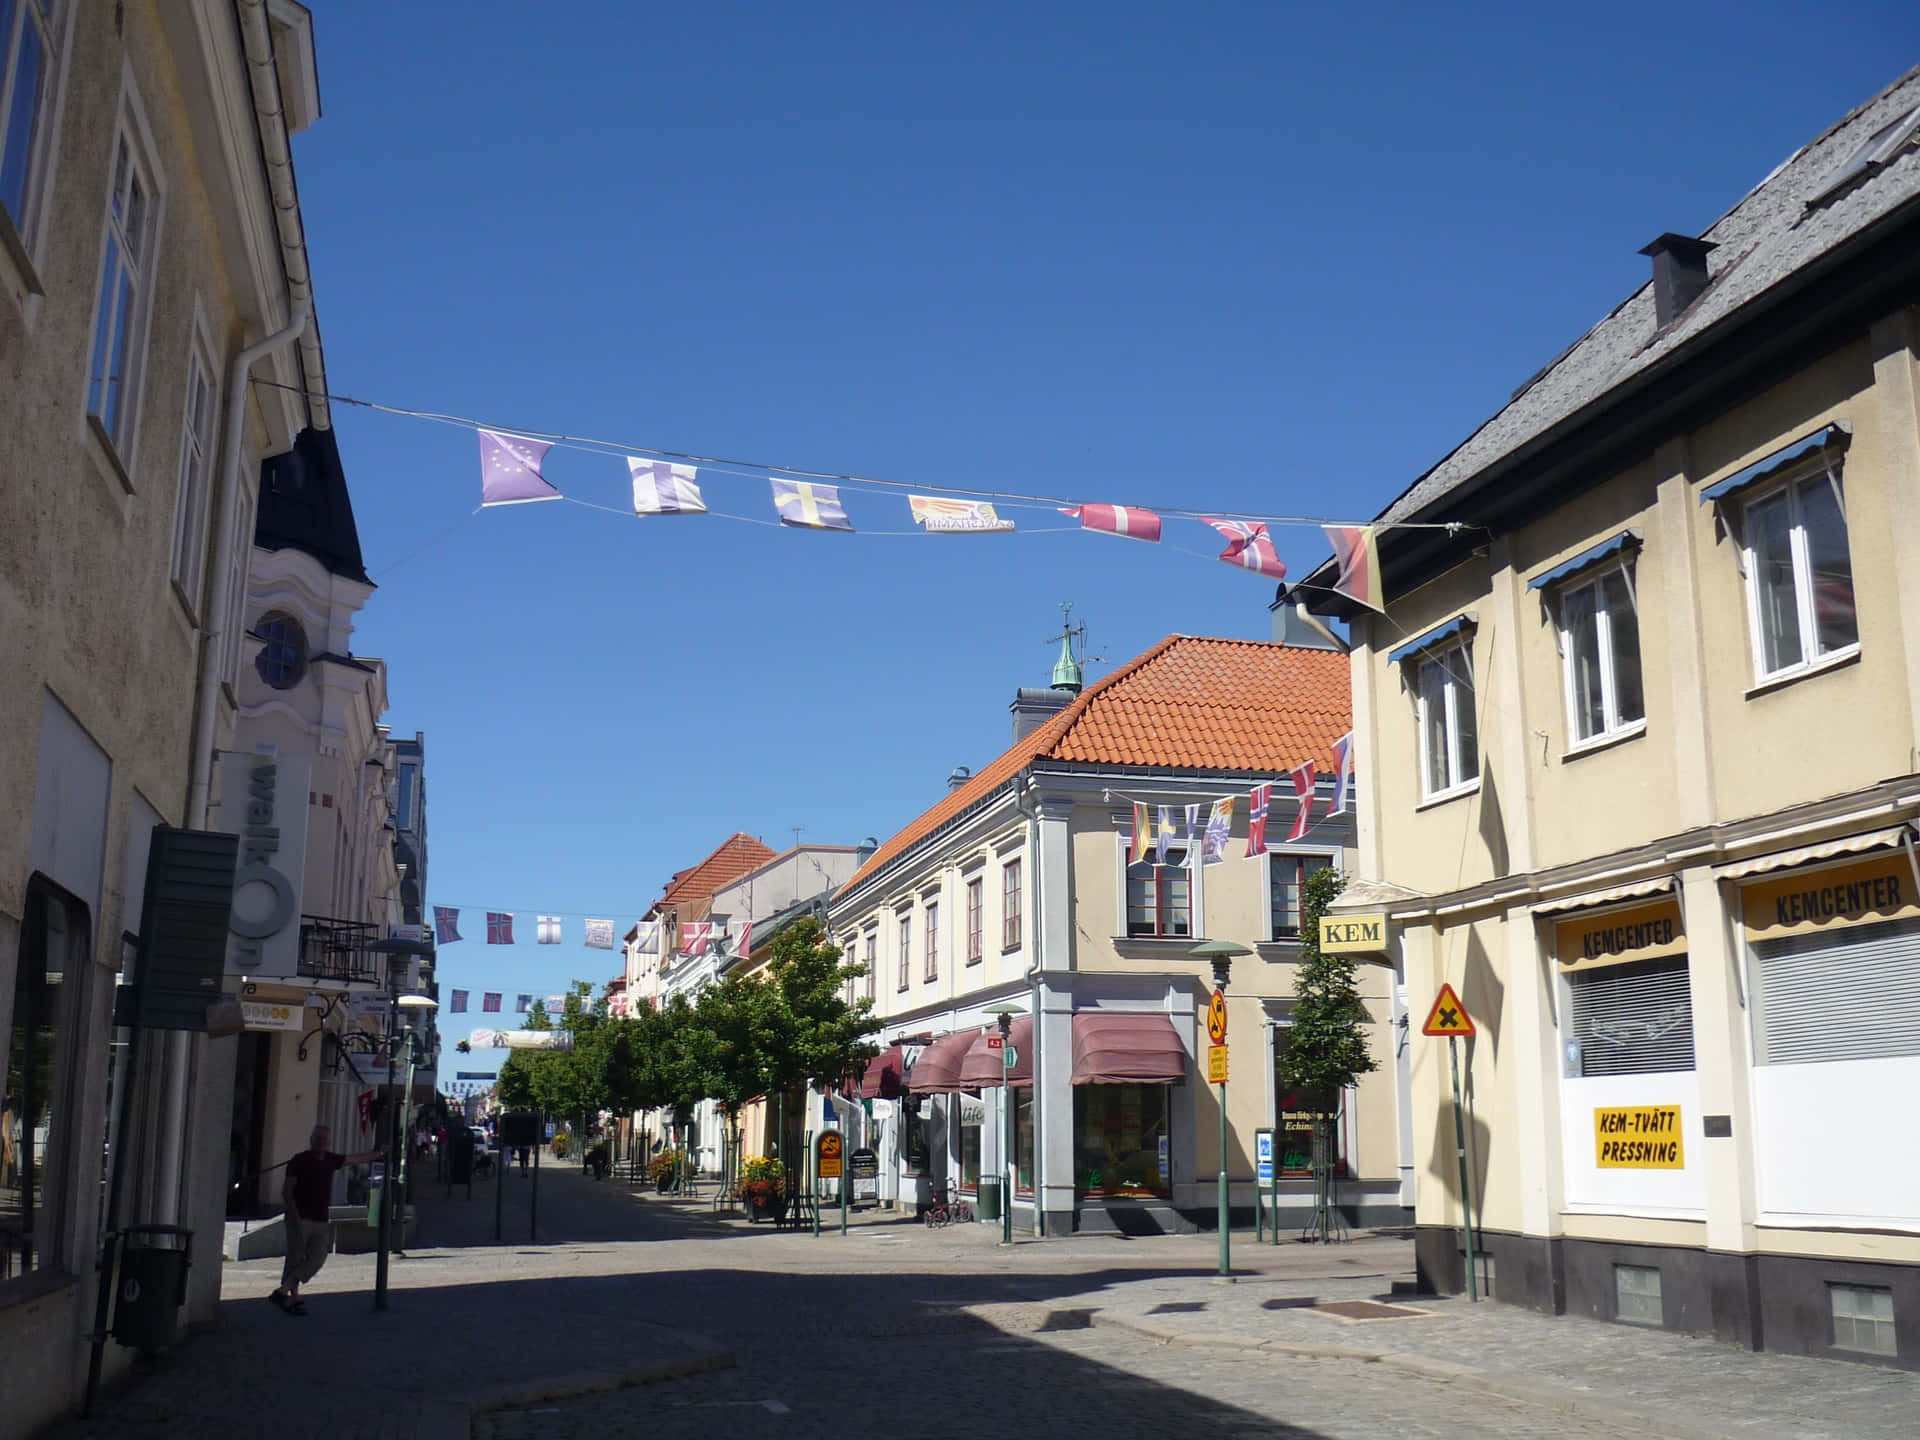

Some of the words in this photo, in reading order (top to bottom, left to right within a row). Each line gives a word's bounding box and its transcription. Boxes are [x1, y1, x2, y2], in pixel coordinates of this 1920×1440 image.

[1776, 875, 1901, 923] KEMCENTER
[1324, 922, 1381, 943] KEM
[1584, 918, 1673, 957] KEMCENTER
[1600, 1108, 1675, 1133] KEM-TVÄTT
[1602, 1141, 1677, 1162] PRESSNING
